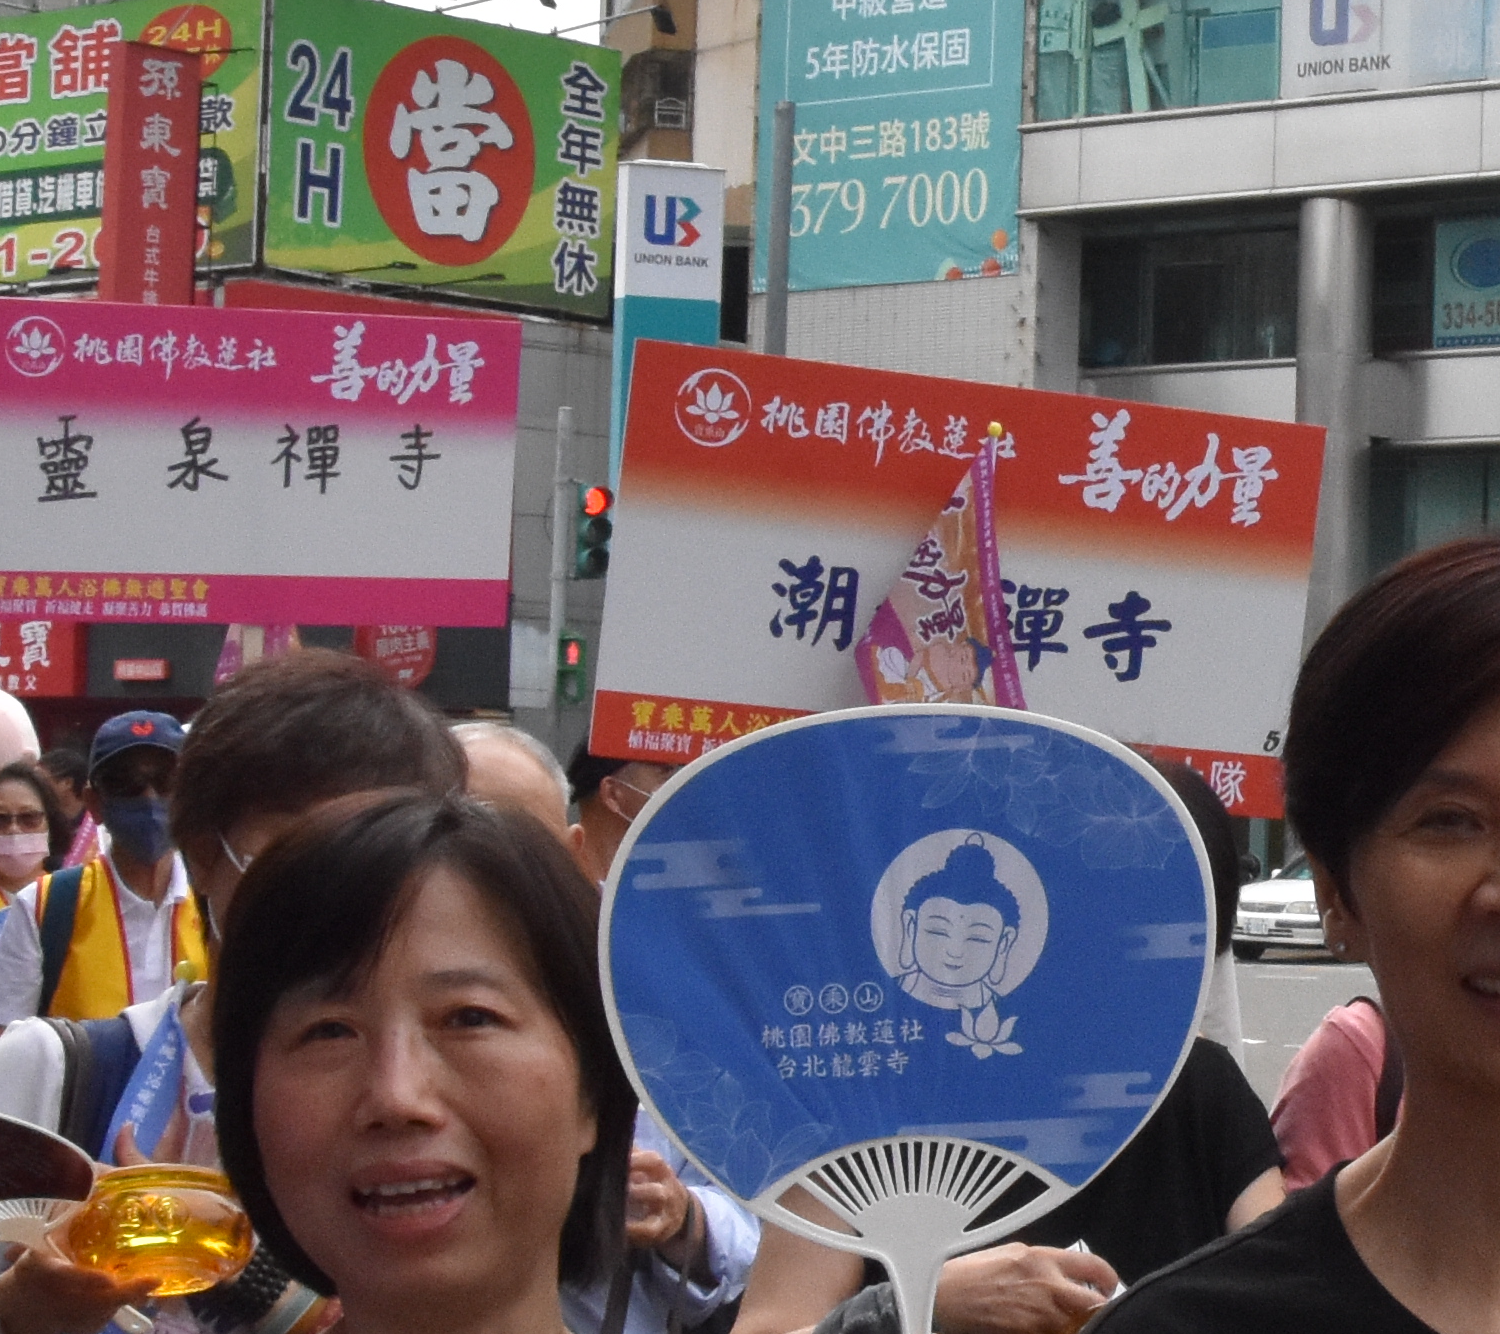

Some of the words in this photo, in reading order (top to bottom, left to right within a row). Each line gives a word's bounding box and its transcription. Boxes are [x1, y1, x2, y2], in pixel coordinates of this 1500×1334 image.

[148, 17, 222, 46] 24H
[805, 27, 972, 80] 5年防水保固
[1296, 57, 1345, 79] UNION
[1348, 54, 1392, 75] BANK
[389, 58, 515, 243] 當
[792, 109, 991, 166] 文中三路183號
[552, 62, 607, 296] 全年無休
[788, 176, 867, 237] 379
[880, 166, 989, 232] 7000
[633, 253, 674, 268] UNION
[675, 253, 709, 268] BANK
[73, 331, 278, 386] 桃園佛教蓮社
[311, 320, 487, 406] 善的力量
[35, 413, 442, 506] 靈泉禪寺
[1058, 408, 1281, 527] 善的力量
[769, 553, 1173, 684] 潮禪寺
[1263, 729, 1281, 752] 5
[761, 1018, 925, 1051] 桃園佛教蓮社
[775, 1051, 910, 1082] 台北龍雲寺
